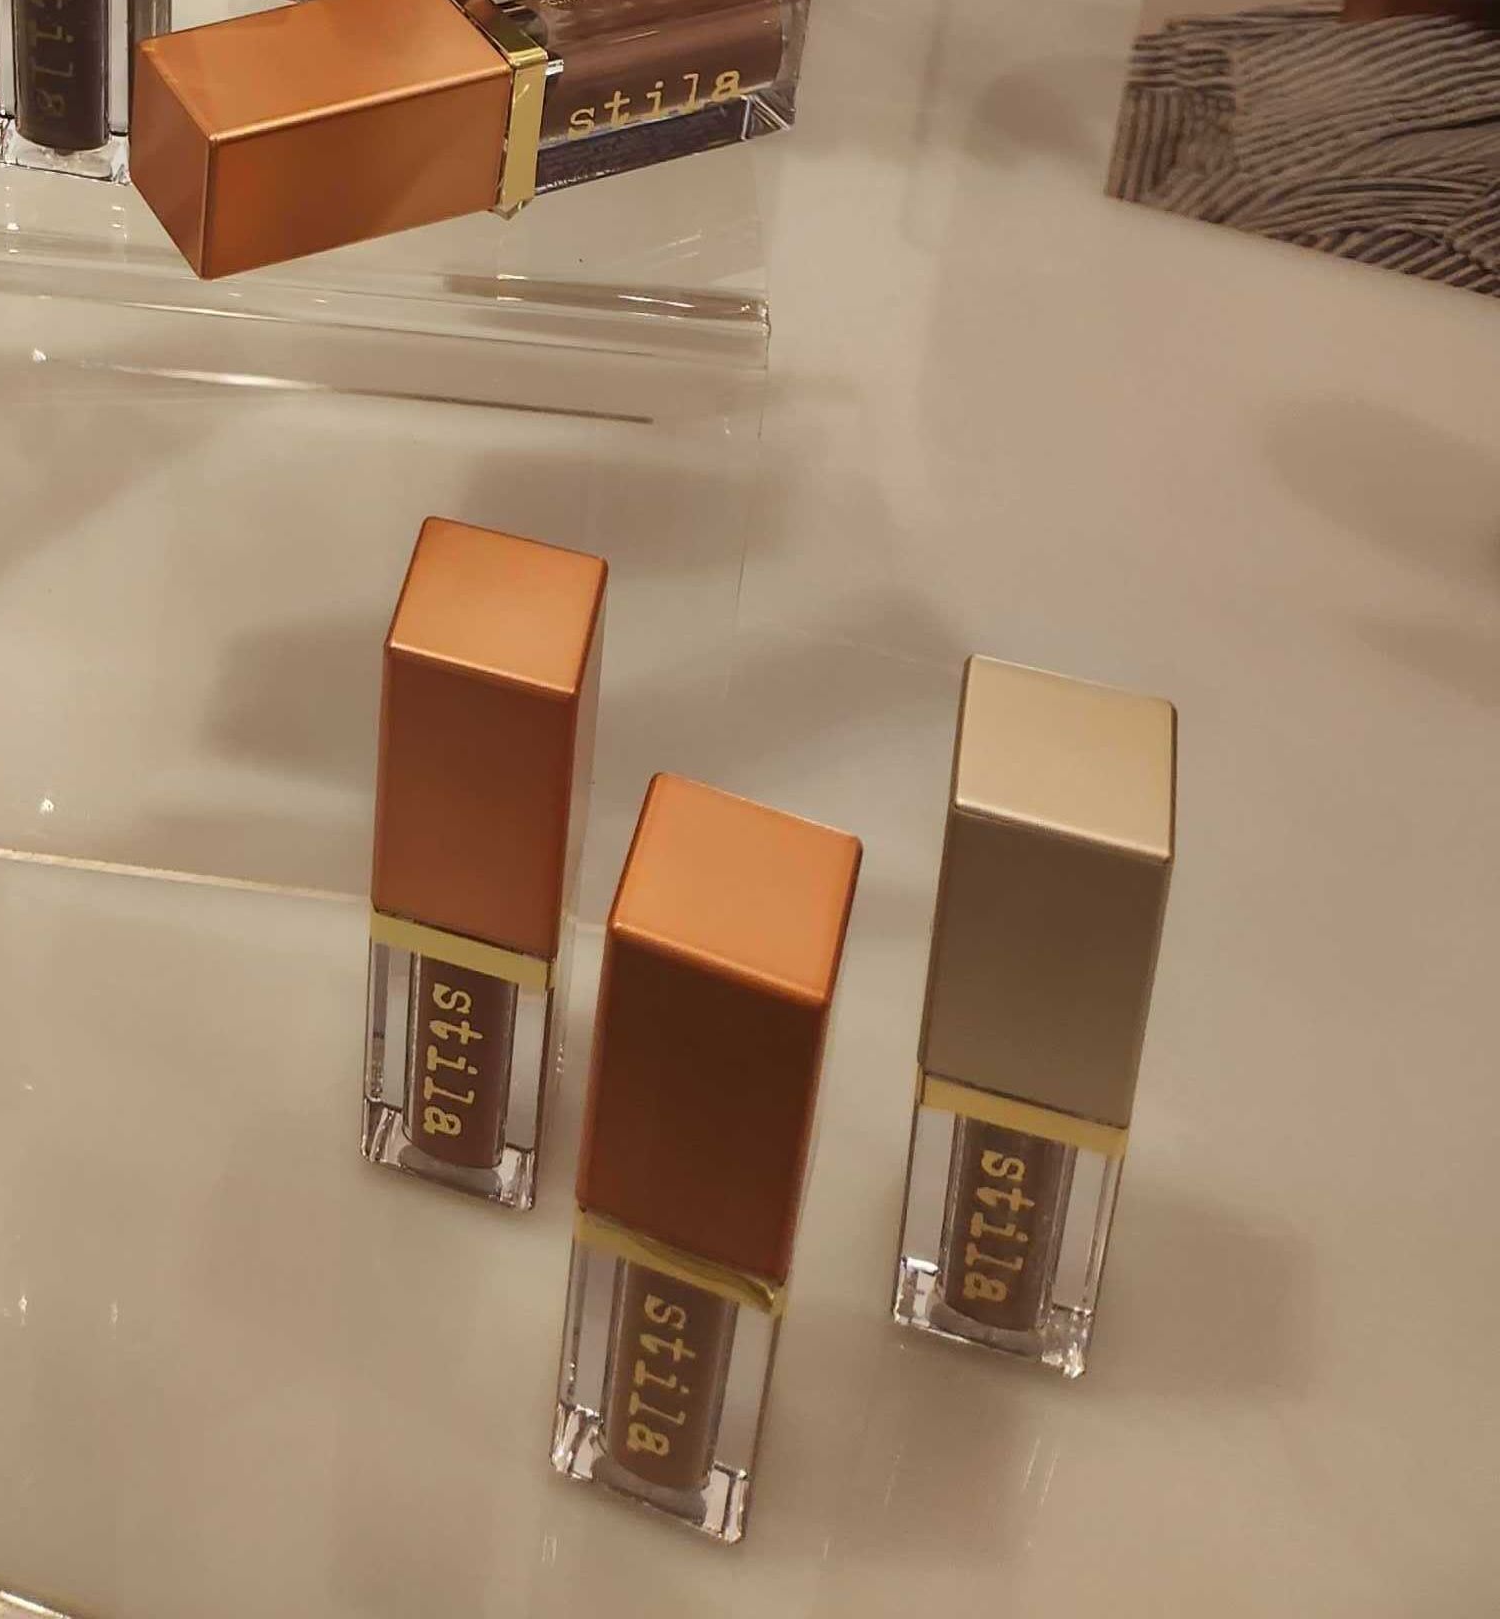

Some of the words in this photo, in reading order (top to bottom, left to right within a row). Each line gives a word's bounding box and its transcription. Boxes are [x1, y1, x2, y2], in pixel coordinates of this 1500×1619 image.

[567, 69, 742, 140] stila
[422, 981, 484, 1140] stila
[963, 1148, 1035, 1304] stila
[625, 1292, 697, 1458] stila
